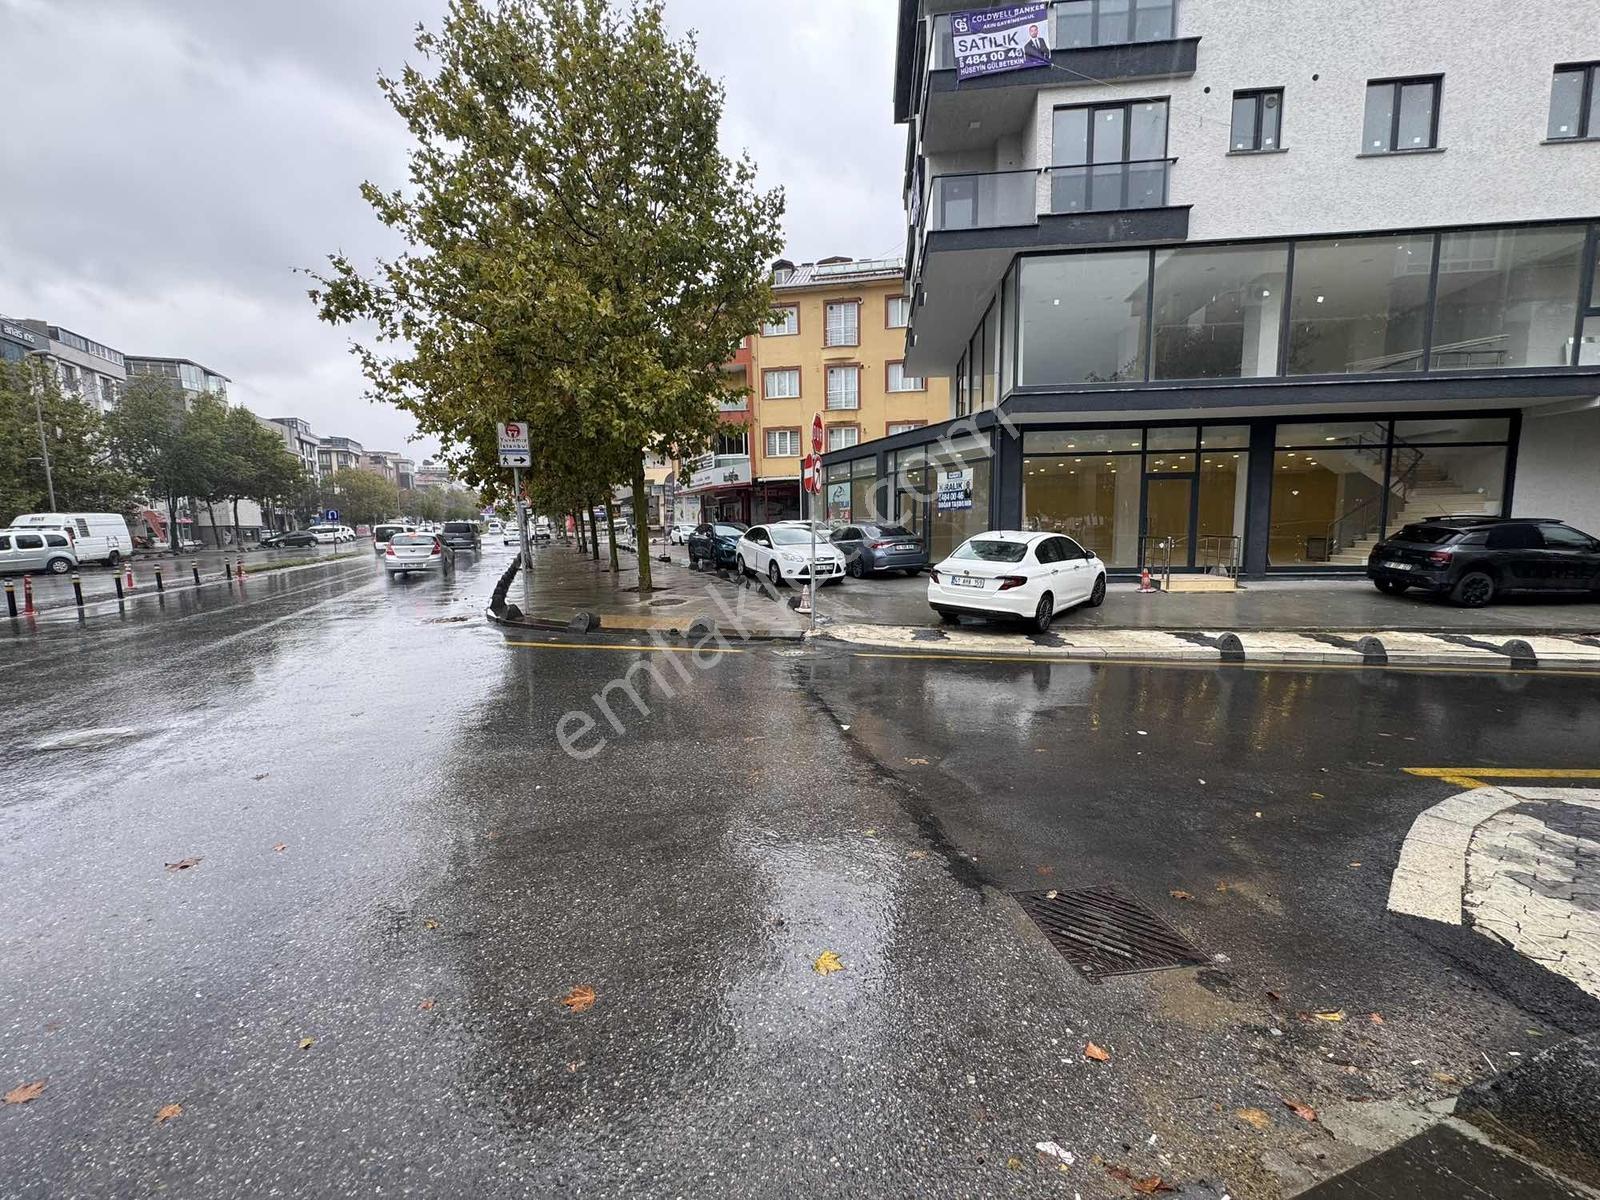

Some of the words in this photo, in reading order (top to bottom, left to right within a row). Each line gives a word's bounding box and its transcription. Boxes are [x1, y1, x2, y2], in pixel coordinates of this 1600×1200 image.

[971, 9, 1014, 23] COLDWELL
[1014, 3, 1045, 15] BANKER
[958, 31, 1019, 52] SATILIK
[965, 54, 987, 65] 484
[990, 51, 1005, 61] 00
[960, 63, 986, 75] HÜSEYİN
